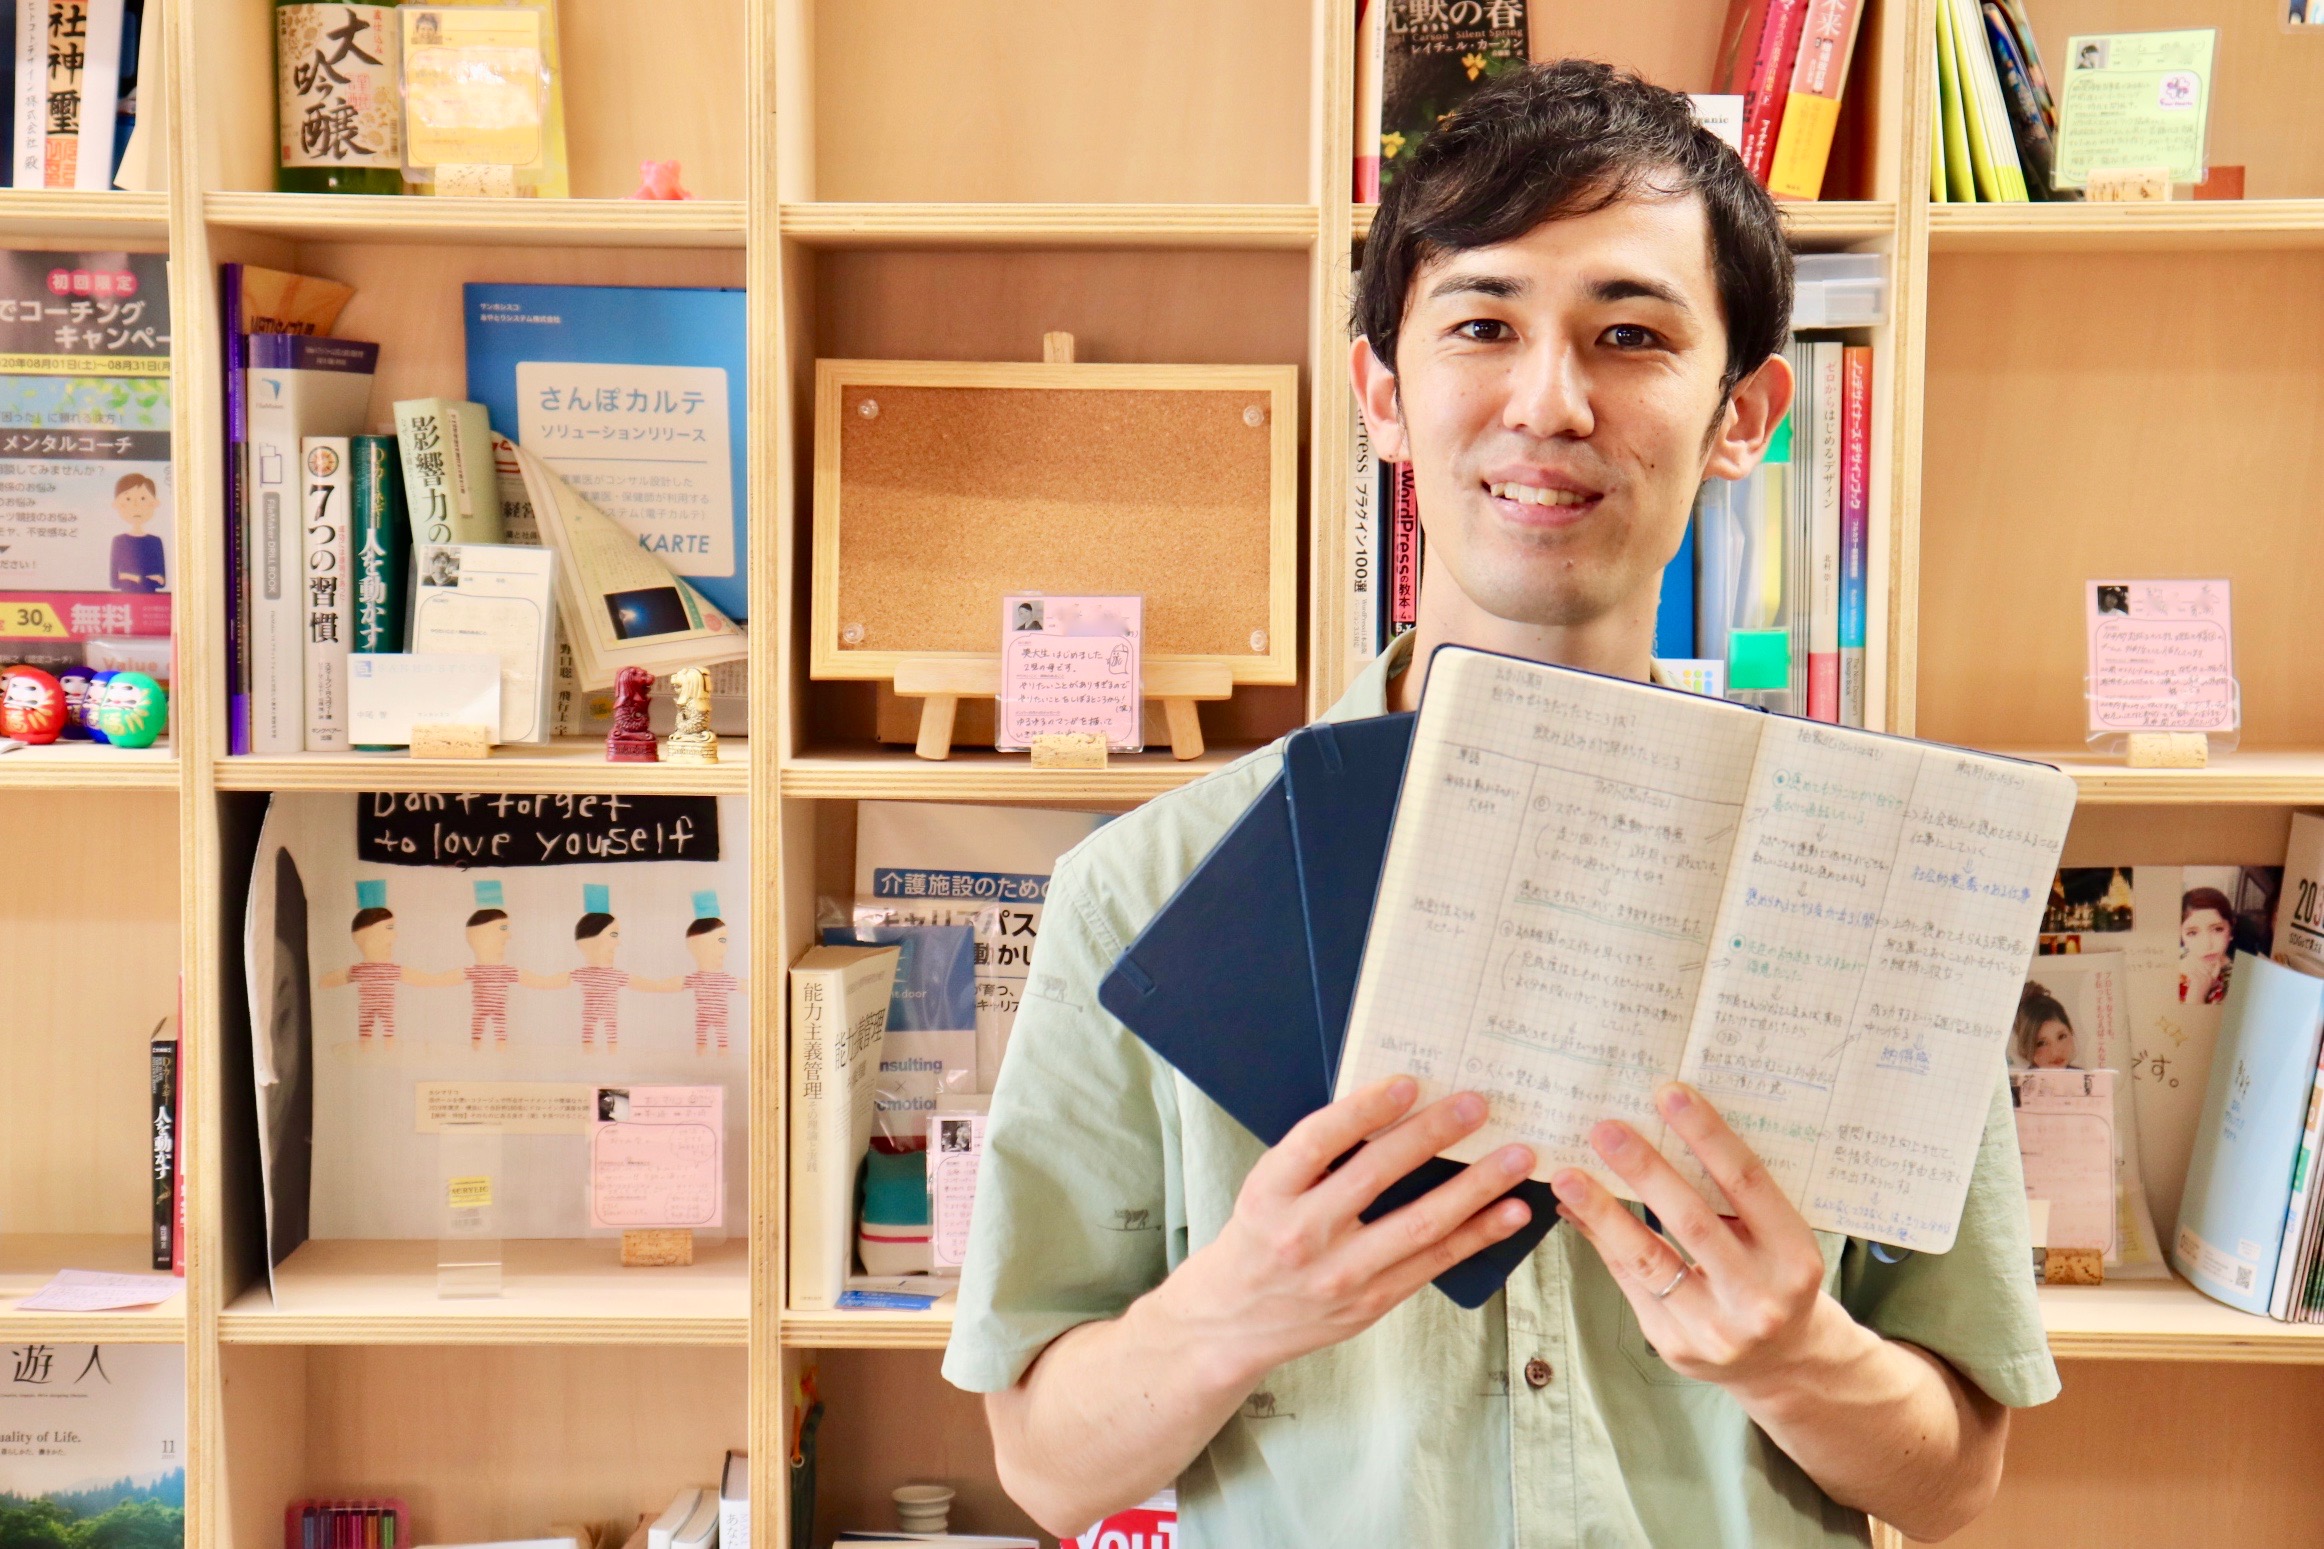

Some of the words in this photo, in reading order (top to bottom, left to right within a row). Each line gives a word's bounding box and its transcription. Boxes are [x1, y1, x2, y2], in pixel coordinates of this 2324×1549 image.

[1411, 38, 1525, 54] レイチェル・カーソン
[1489, 29, 1523, 39] Spring
[52, 273, 134, 292] 初回限定
[540, 386, 706, 415] さんぽカルテ
[4, 435, 132, 453] メンタルコーチ
[541, 425, 706, 442] ソリューションリリース
[1823, 361, 1839, 510] ゼロからはじめるデザイン
[411, 415, 452, 544] 影響力の
[266, 498, 276, 539] FileMaker
[638, 533, 711, 554] KARTE
[1354, 482, 1369, 594] プラグイン100選
[266, 541, 276, 565] DRILL
[308, 485, 339, 644] 7つの習慣
[266, 567, 276, 594] BOOK
[358, 527, 387, 650] 人を動かす
[71, 603, 133, 634] 無料
[1852, 658, 1860, 670] The
[374, 829, 417, 853] to
[434, 822, 511, 860] love
[902, 988, 927, 998] door
[803, 982, 823, 1101] 能力主義管理
[879, 1058, 943, 1073] nsulting
[153, 1105, 172, 1180] 人を動かす
[36, 1431, 49, 1443] of
[54, 1431, 81, 1443] Life.
[161, 1440, 176, 1454] 11
